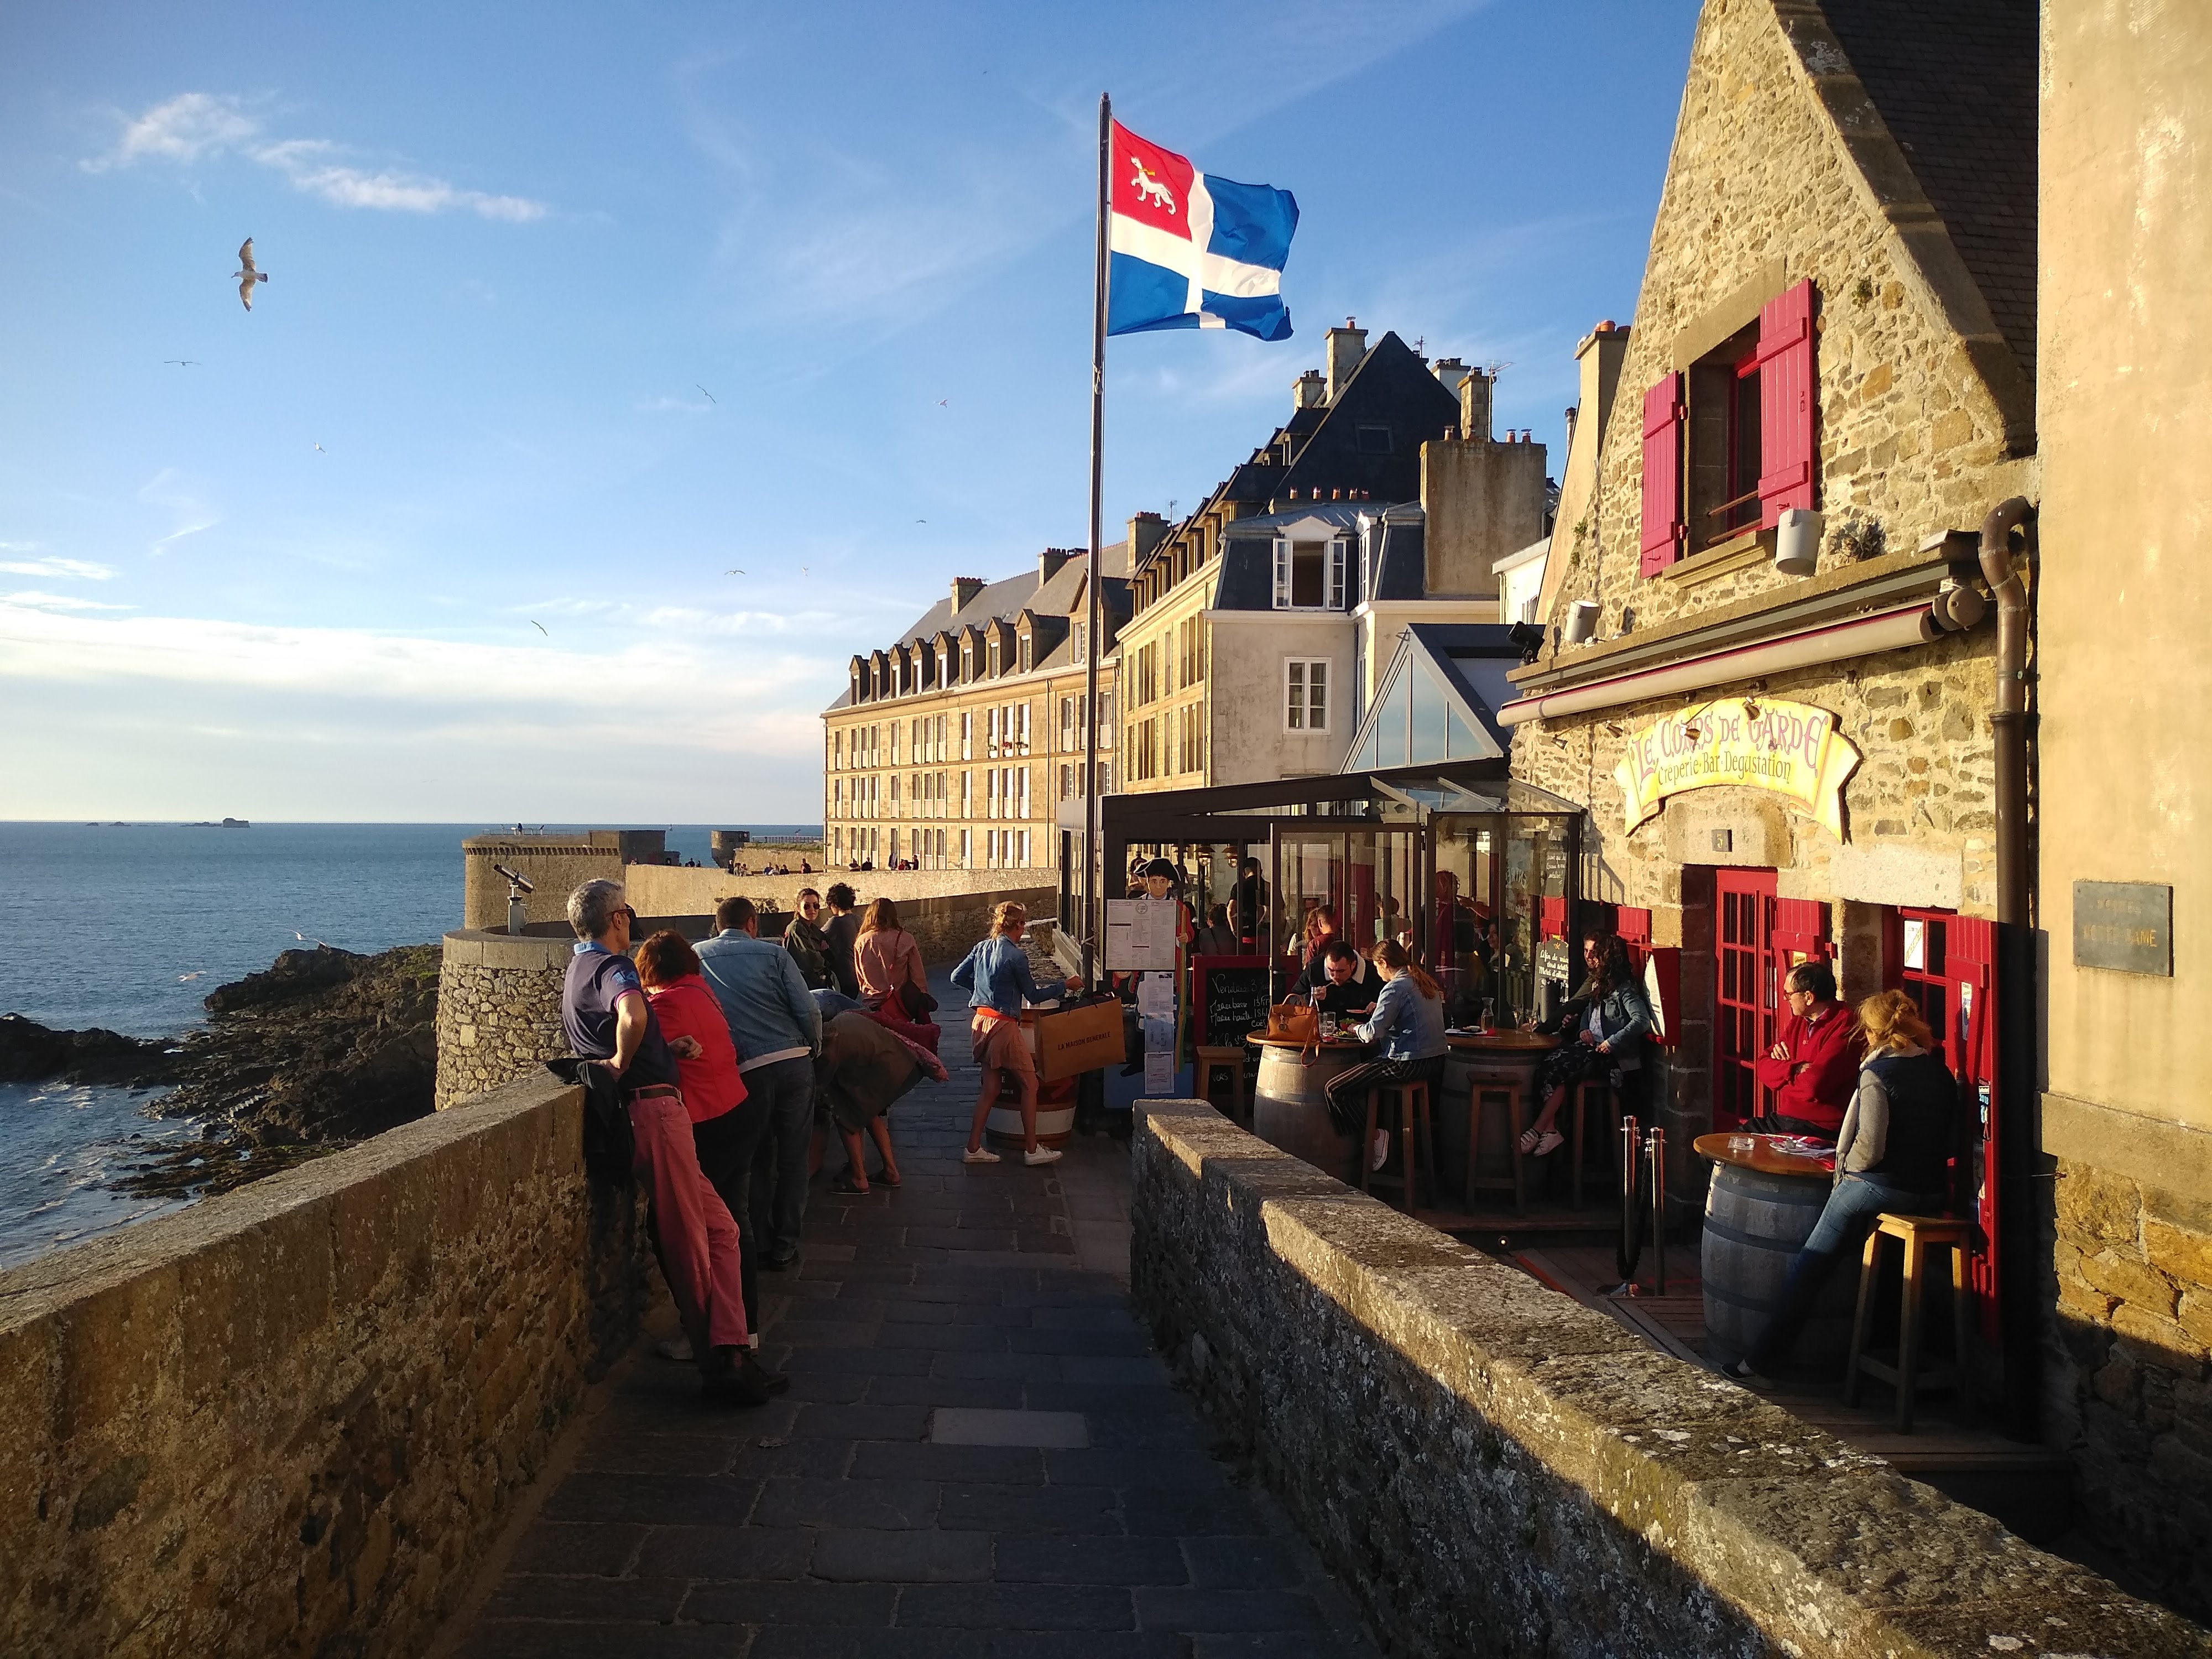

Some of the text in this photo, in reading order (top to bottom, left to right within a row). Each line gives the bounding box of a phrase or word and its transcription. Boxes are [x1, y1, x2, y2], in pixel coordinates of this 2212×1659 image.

[1632, 733, 1658, 791] LE
[1719, 714, 1740, 745] DE
[1746, 704, 1828, 778] GARDE
[1702, 752, 1720, 774] Bar
[1538, 966, 1551, 976] Merci
[1066, 1039, 1086, 1048] MAISON
[1086, 1031, 1111, 1043] GENERALE
